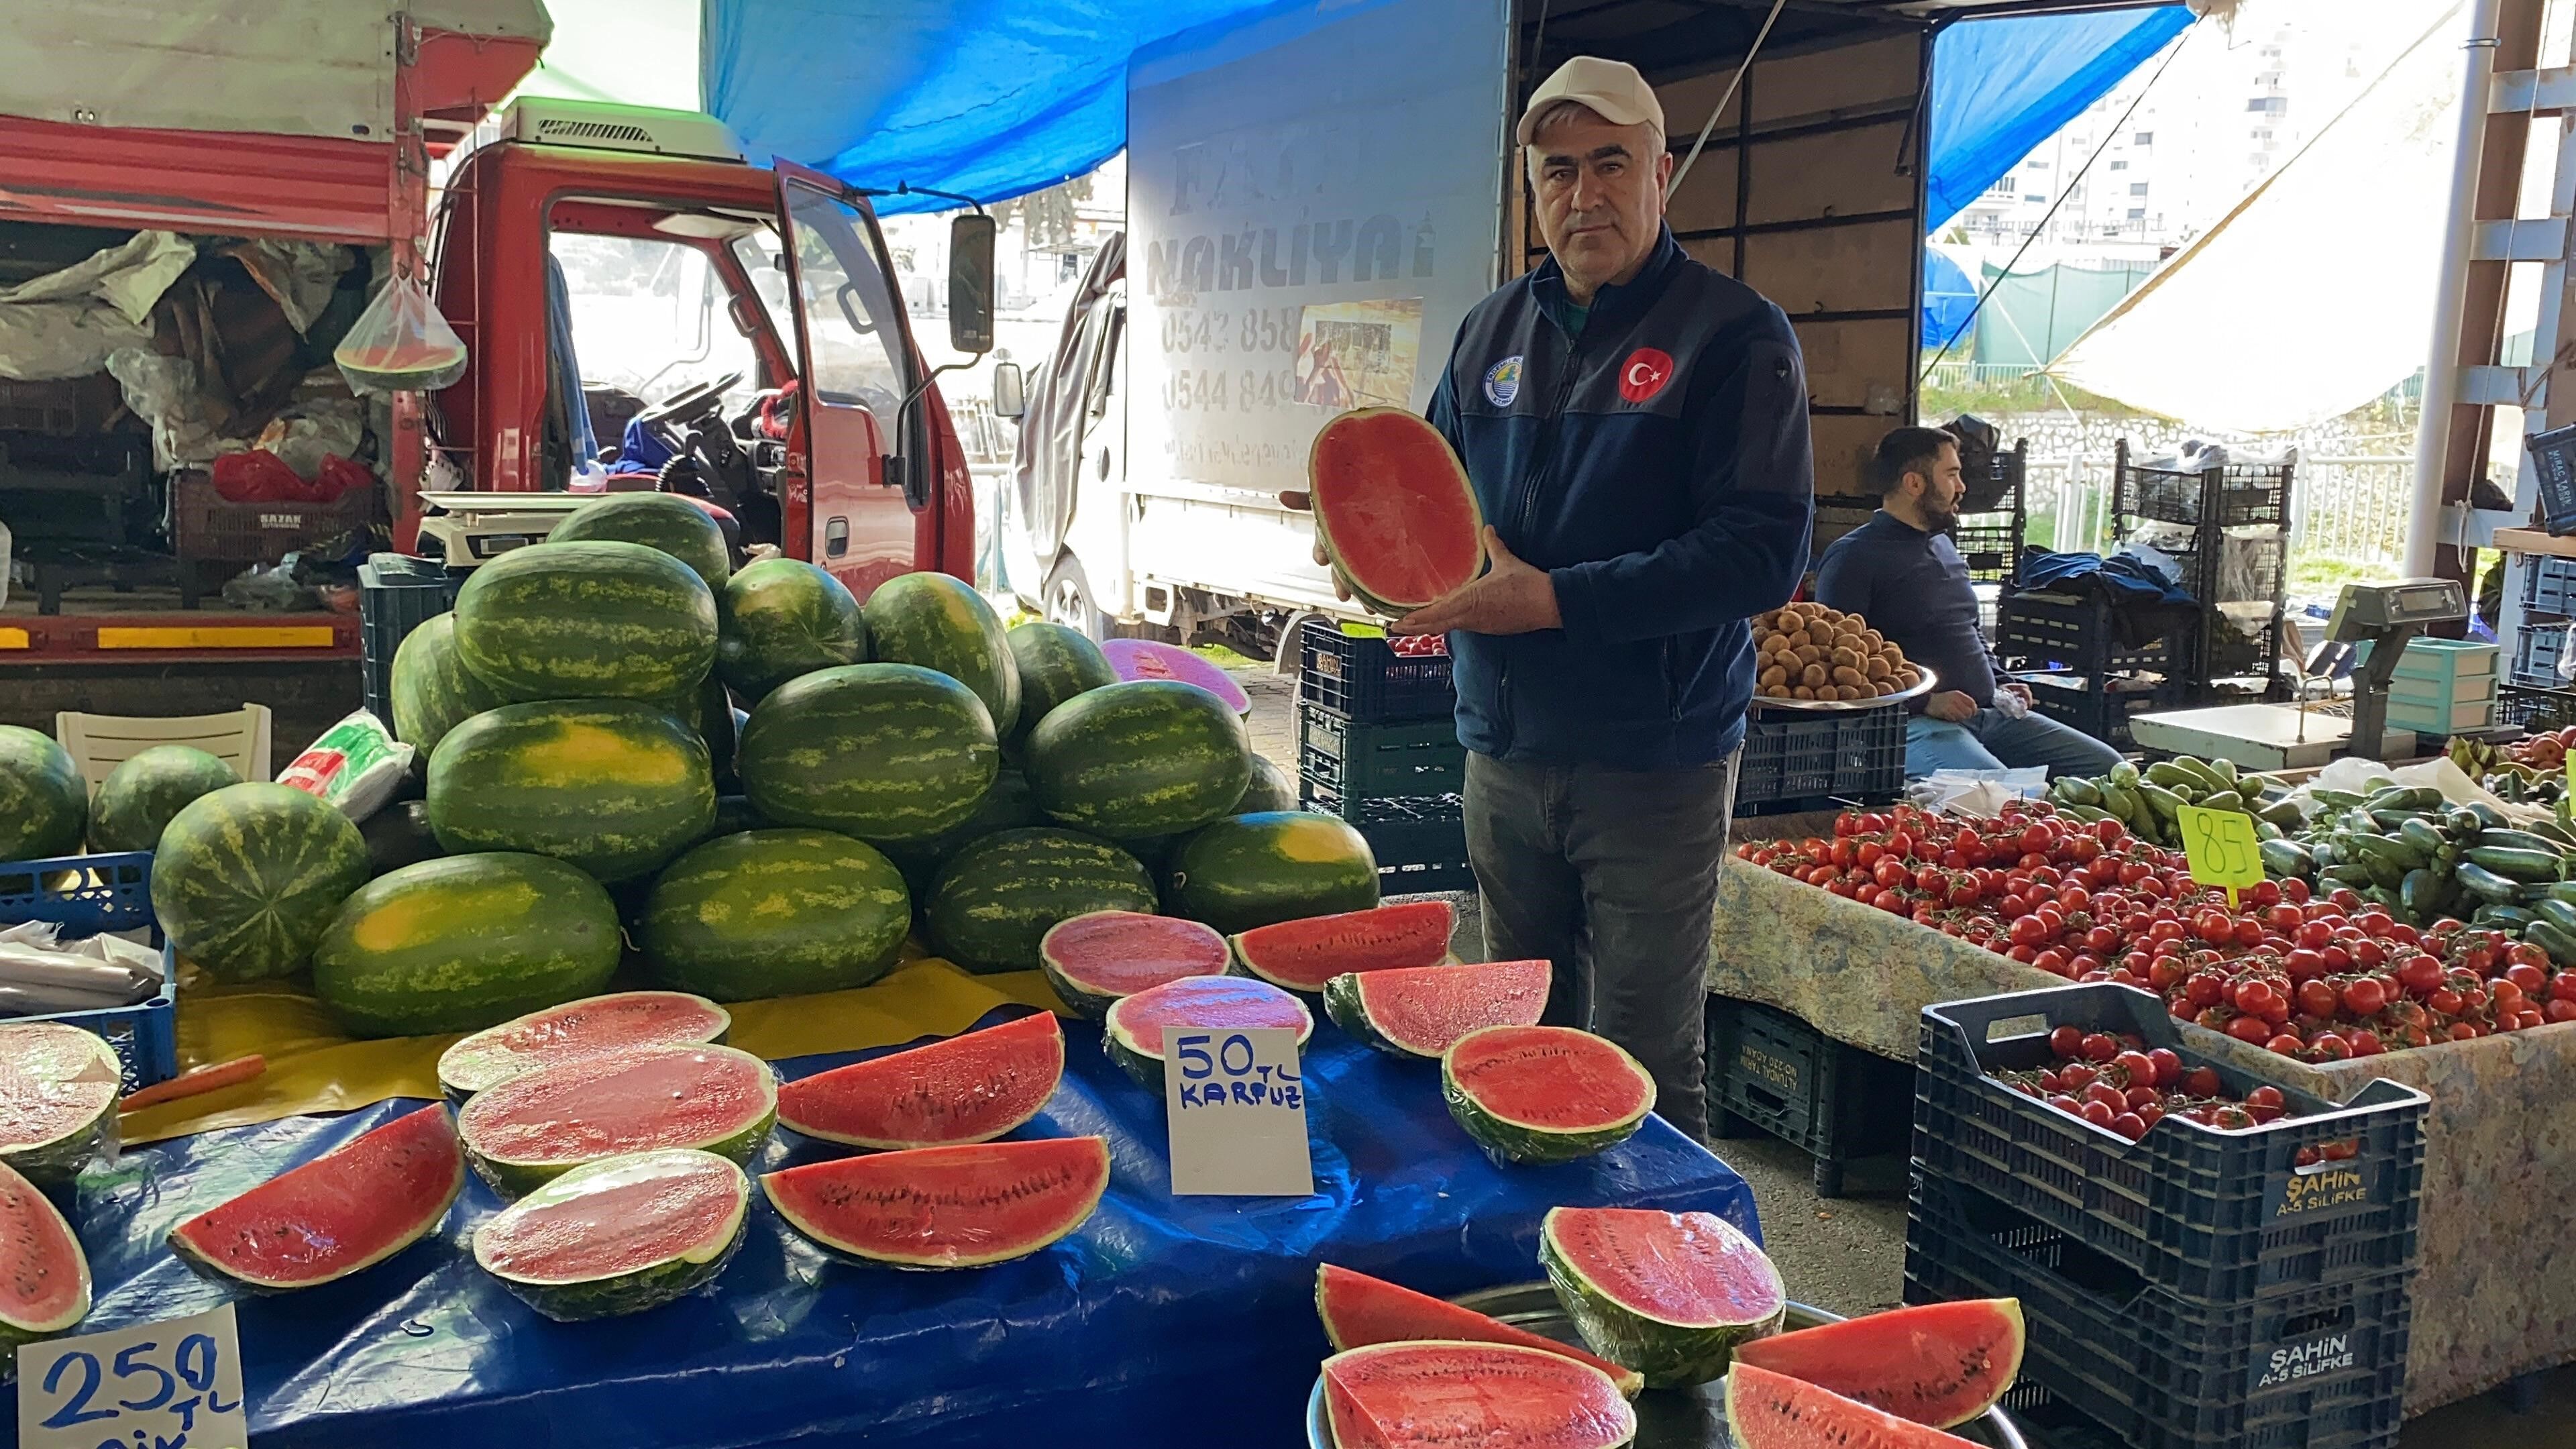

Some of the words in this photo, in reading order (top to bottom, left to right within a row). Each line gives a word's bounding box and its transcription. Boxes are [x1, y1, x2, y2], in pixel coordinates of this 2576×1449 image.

[2196, 812, 2248, 874] 85
[1741, 1044, 1768, 1063] ADANA
[1179, 1081, 1303, 1110] KARPUZ
[2276, 1199, 2302, 1217] A-5
[2269, 1334, 2347, 1373] ŞAHİN
[2258, 1368, 2289, 1387] A-5
